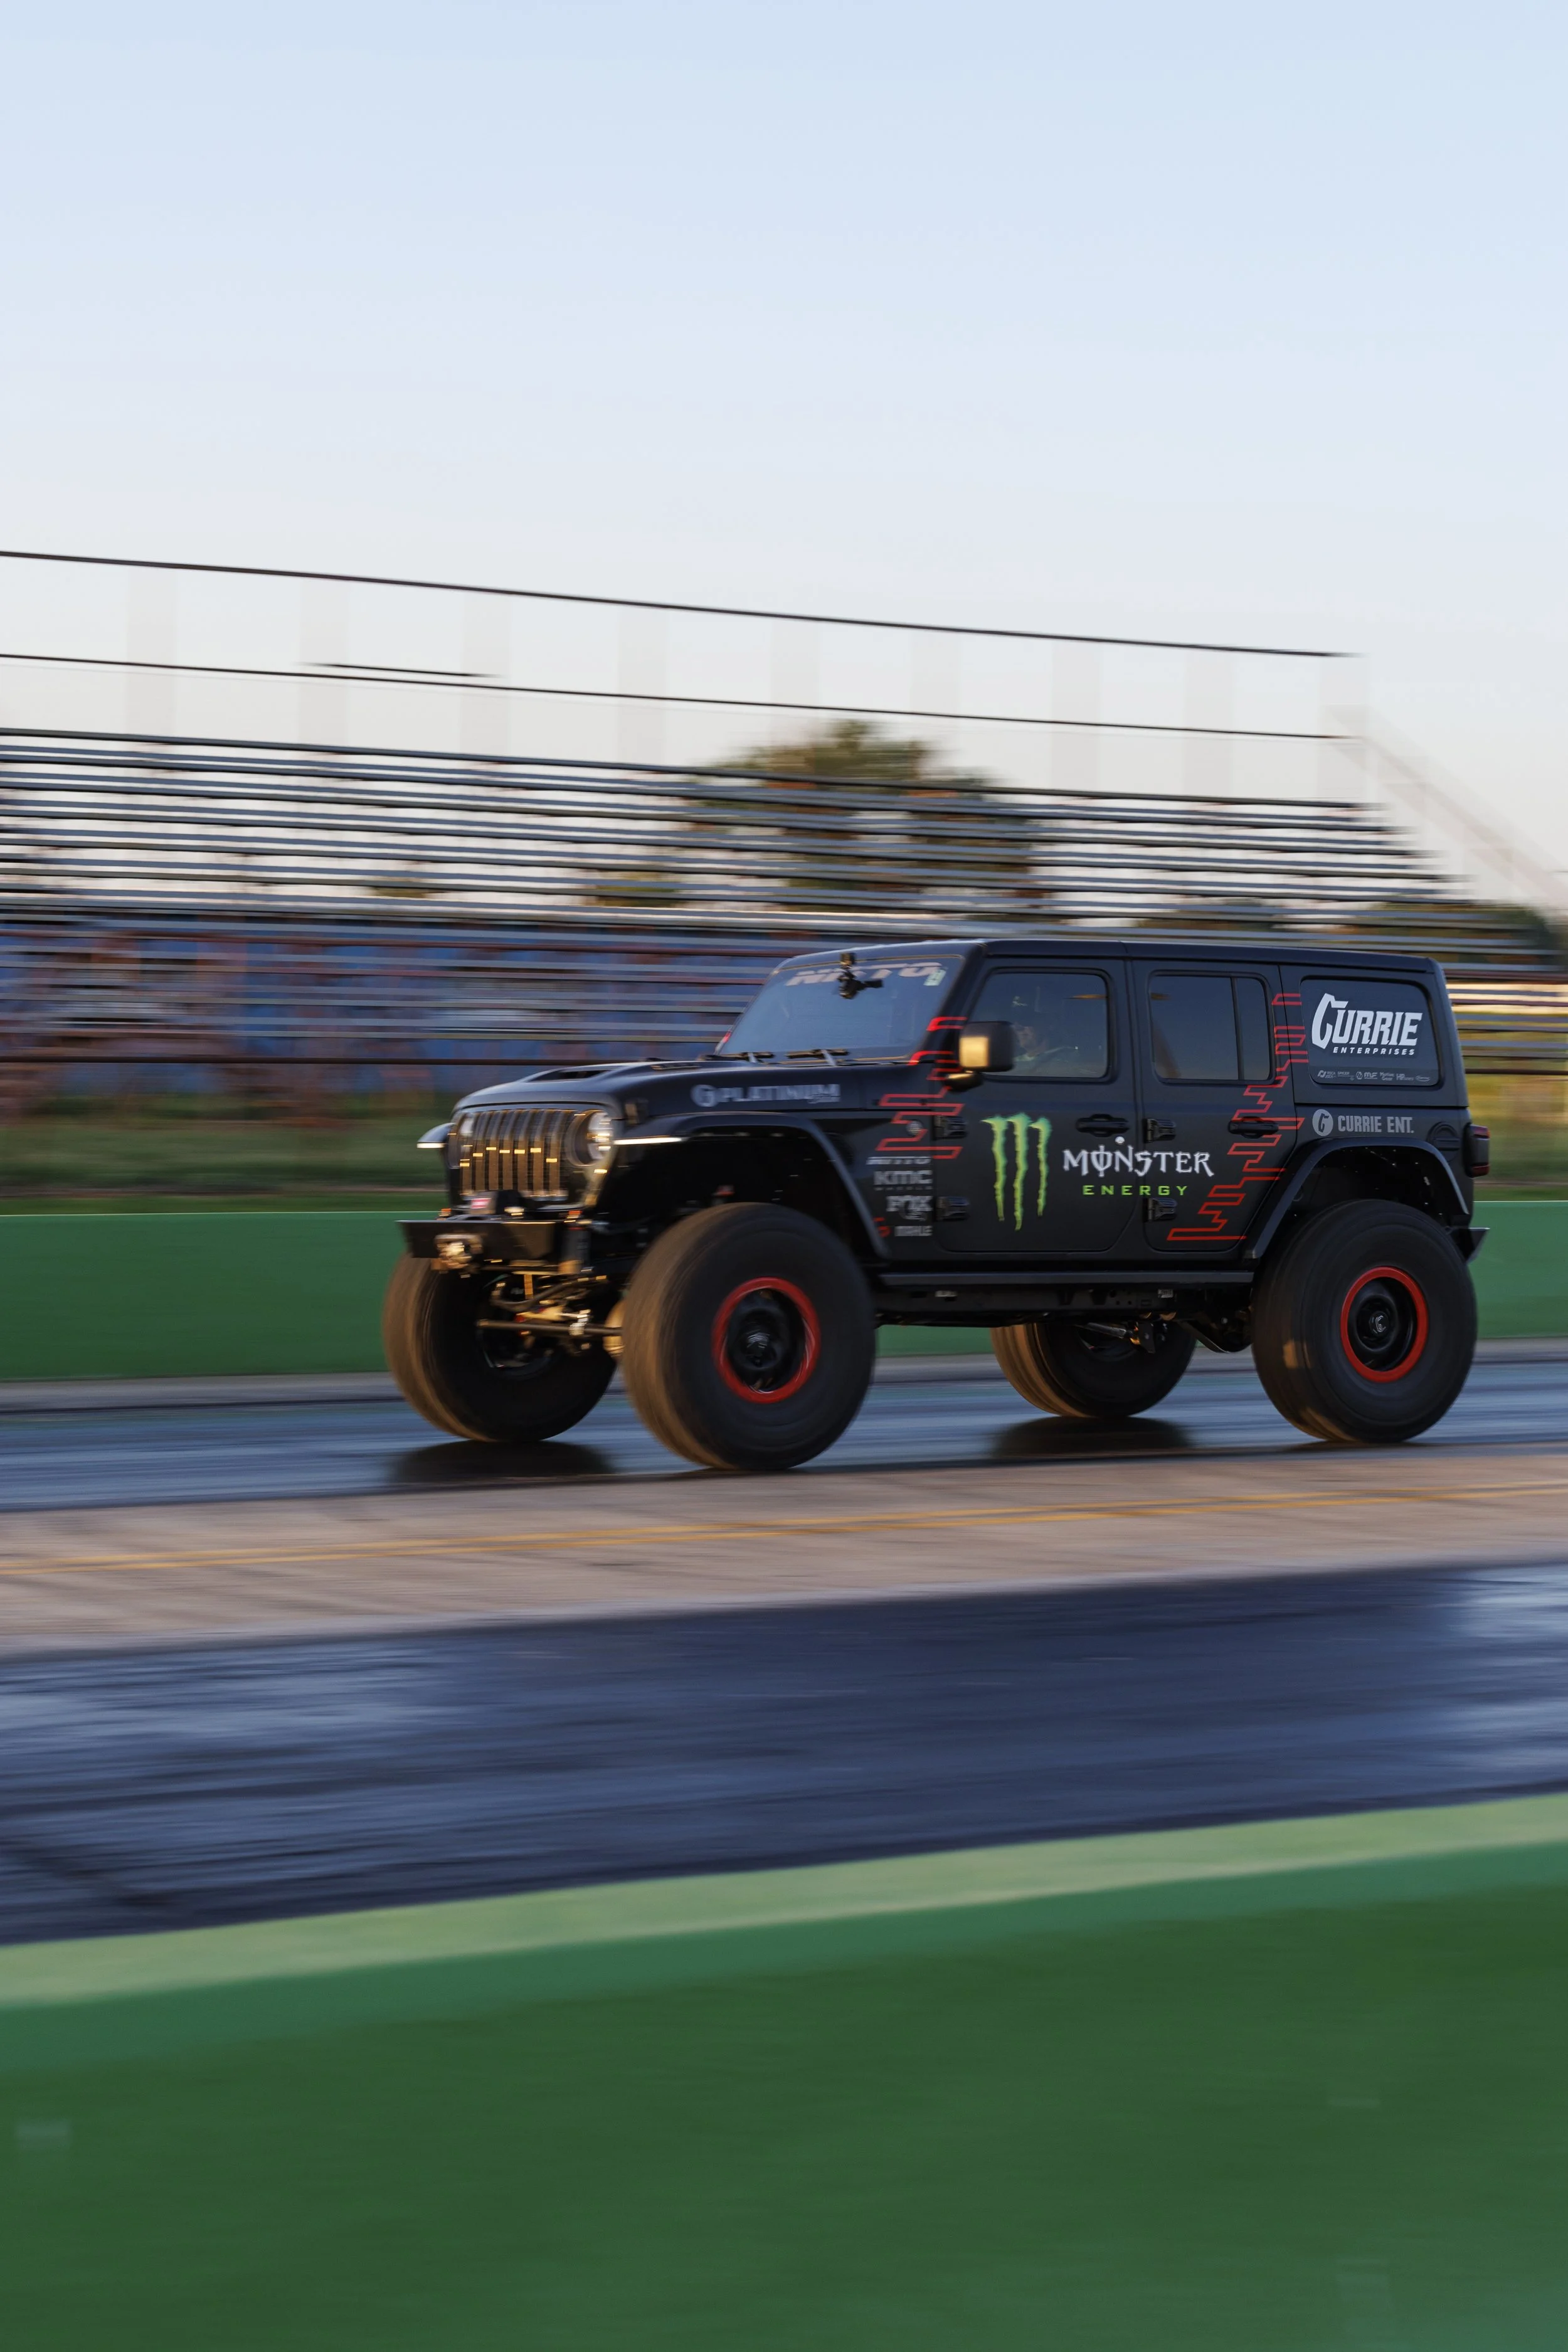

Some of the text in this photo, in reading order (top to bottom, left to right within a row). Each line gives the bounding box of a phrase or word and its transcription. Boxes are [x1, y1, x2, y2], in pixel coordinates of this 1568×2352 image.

[1311, 993, 1422, 1049] CURRIE
[1333, 1047, 1415, 1056] ENTERPRISES
[1338, 1115, 1382, 1133] CURRIE
[1387, 1116, 1414, 1133] ENT.
[1062, 1145, 1214, 1177] MONSTER
[1083, 1185, 1188, 1196] ENERGY
